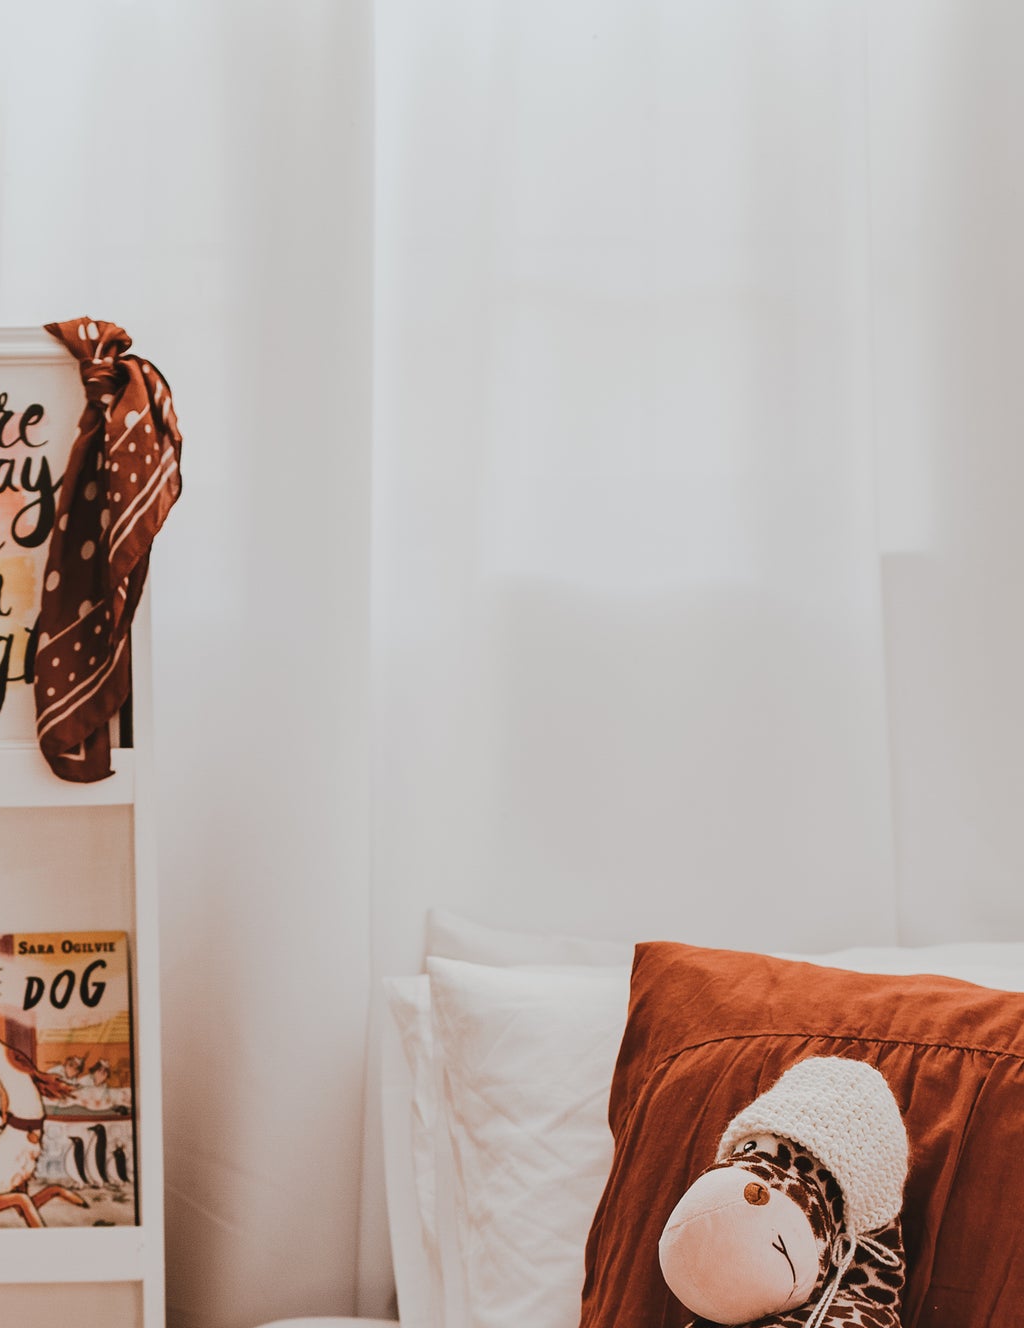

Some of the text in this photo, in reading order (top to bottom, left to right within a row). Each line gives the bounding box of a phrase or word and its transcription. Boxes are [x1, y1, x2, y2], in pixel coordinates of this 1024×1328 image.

[18, 940, 116, 955] SARA OGILVIE
[23, 959, 107, 1011] DOG
